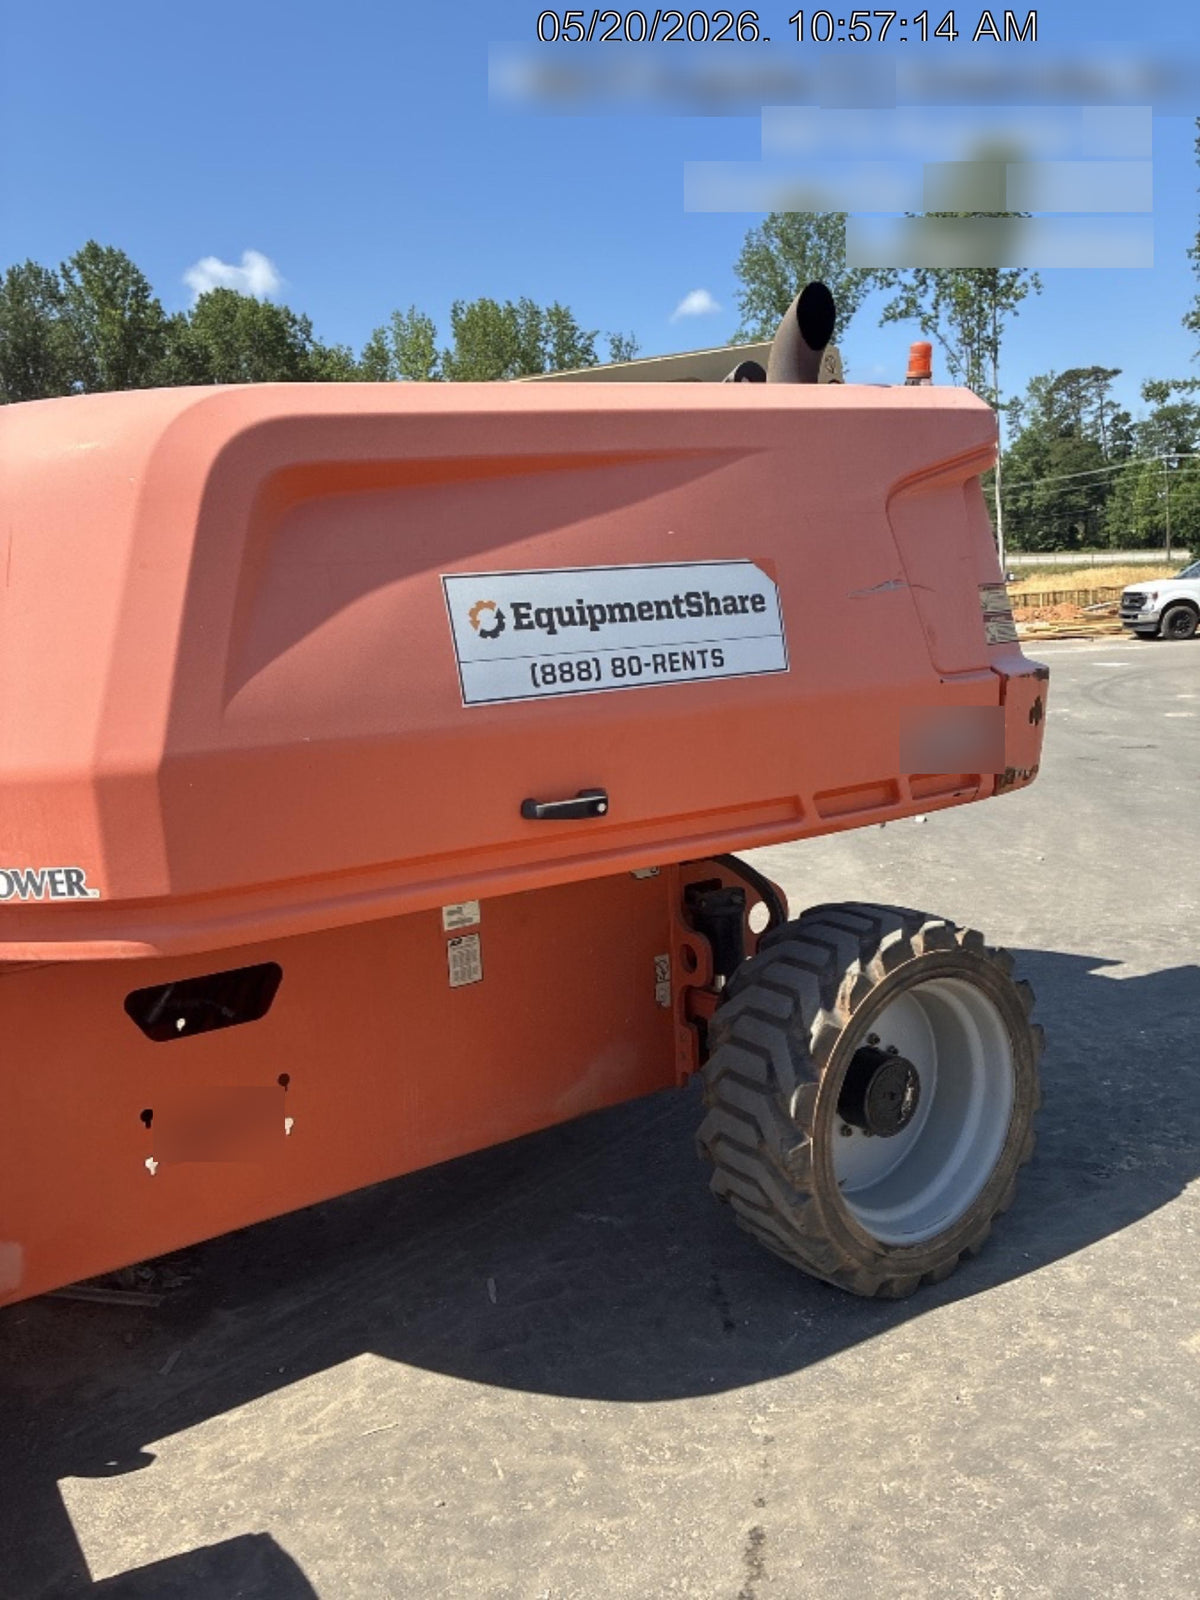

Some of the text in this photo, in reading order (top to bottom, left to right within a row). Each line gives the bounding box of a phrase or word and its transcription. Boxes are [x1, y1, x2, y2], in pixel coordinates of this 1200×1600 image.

[510, 591, 766, 635] EquipmentShare
[531, 648, 725, 688] (888) 80-RENTS
